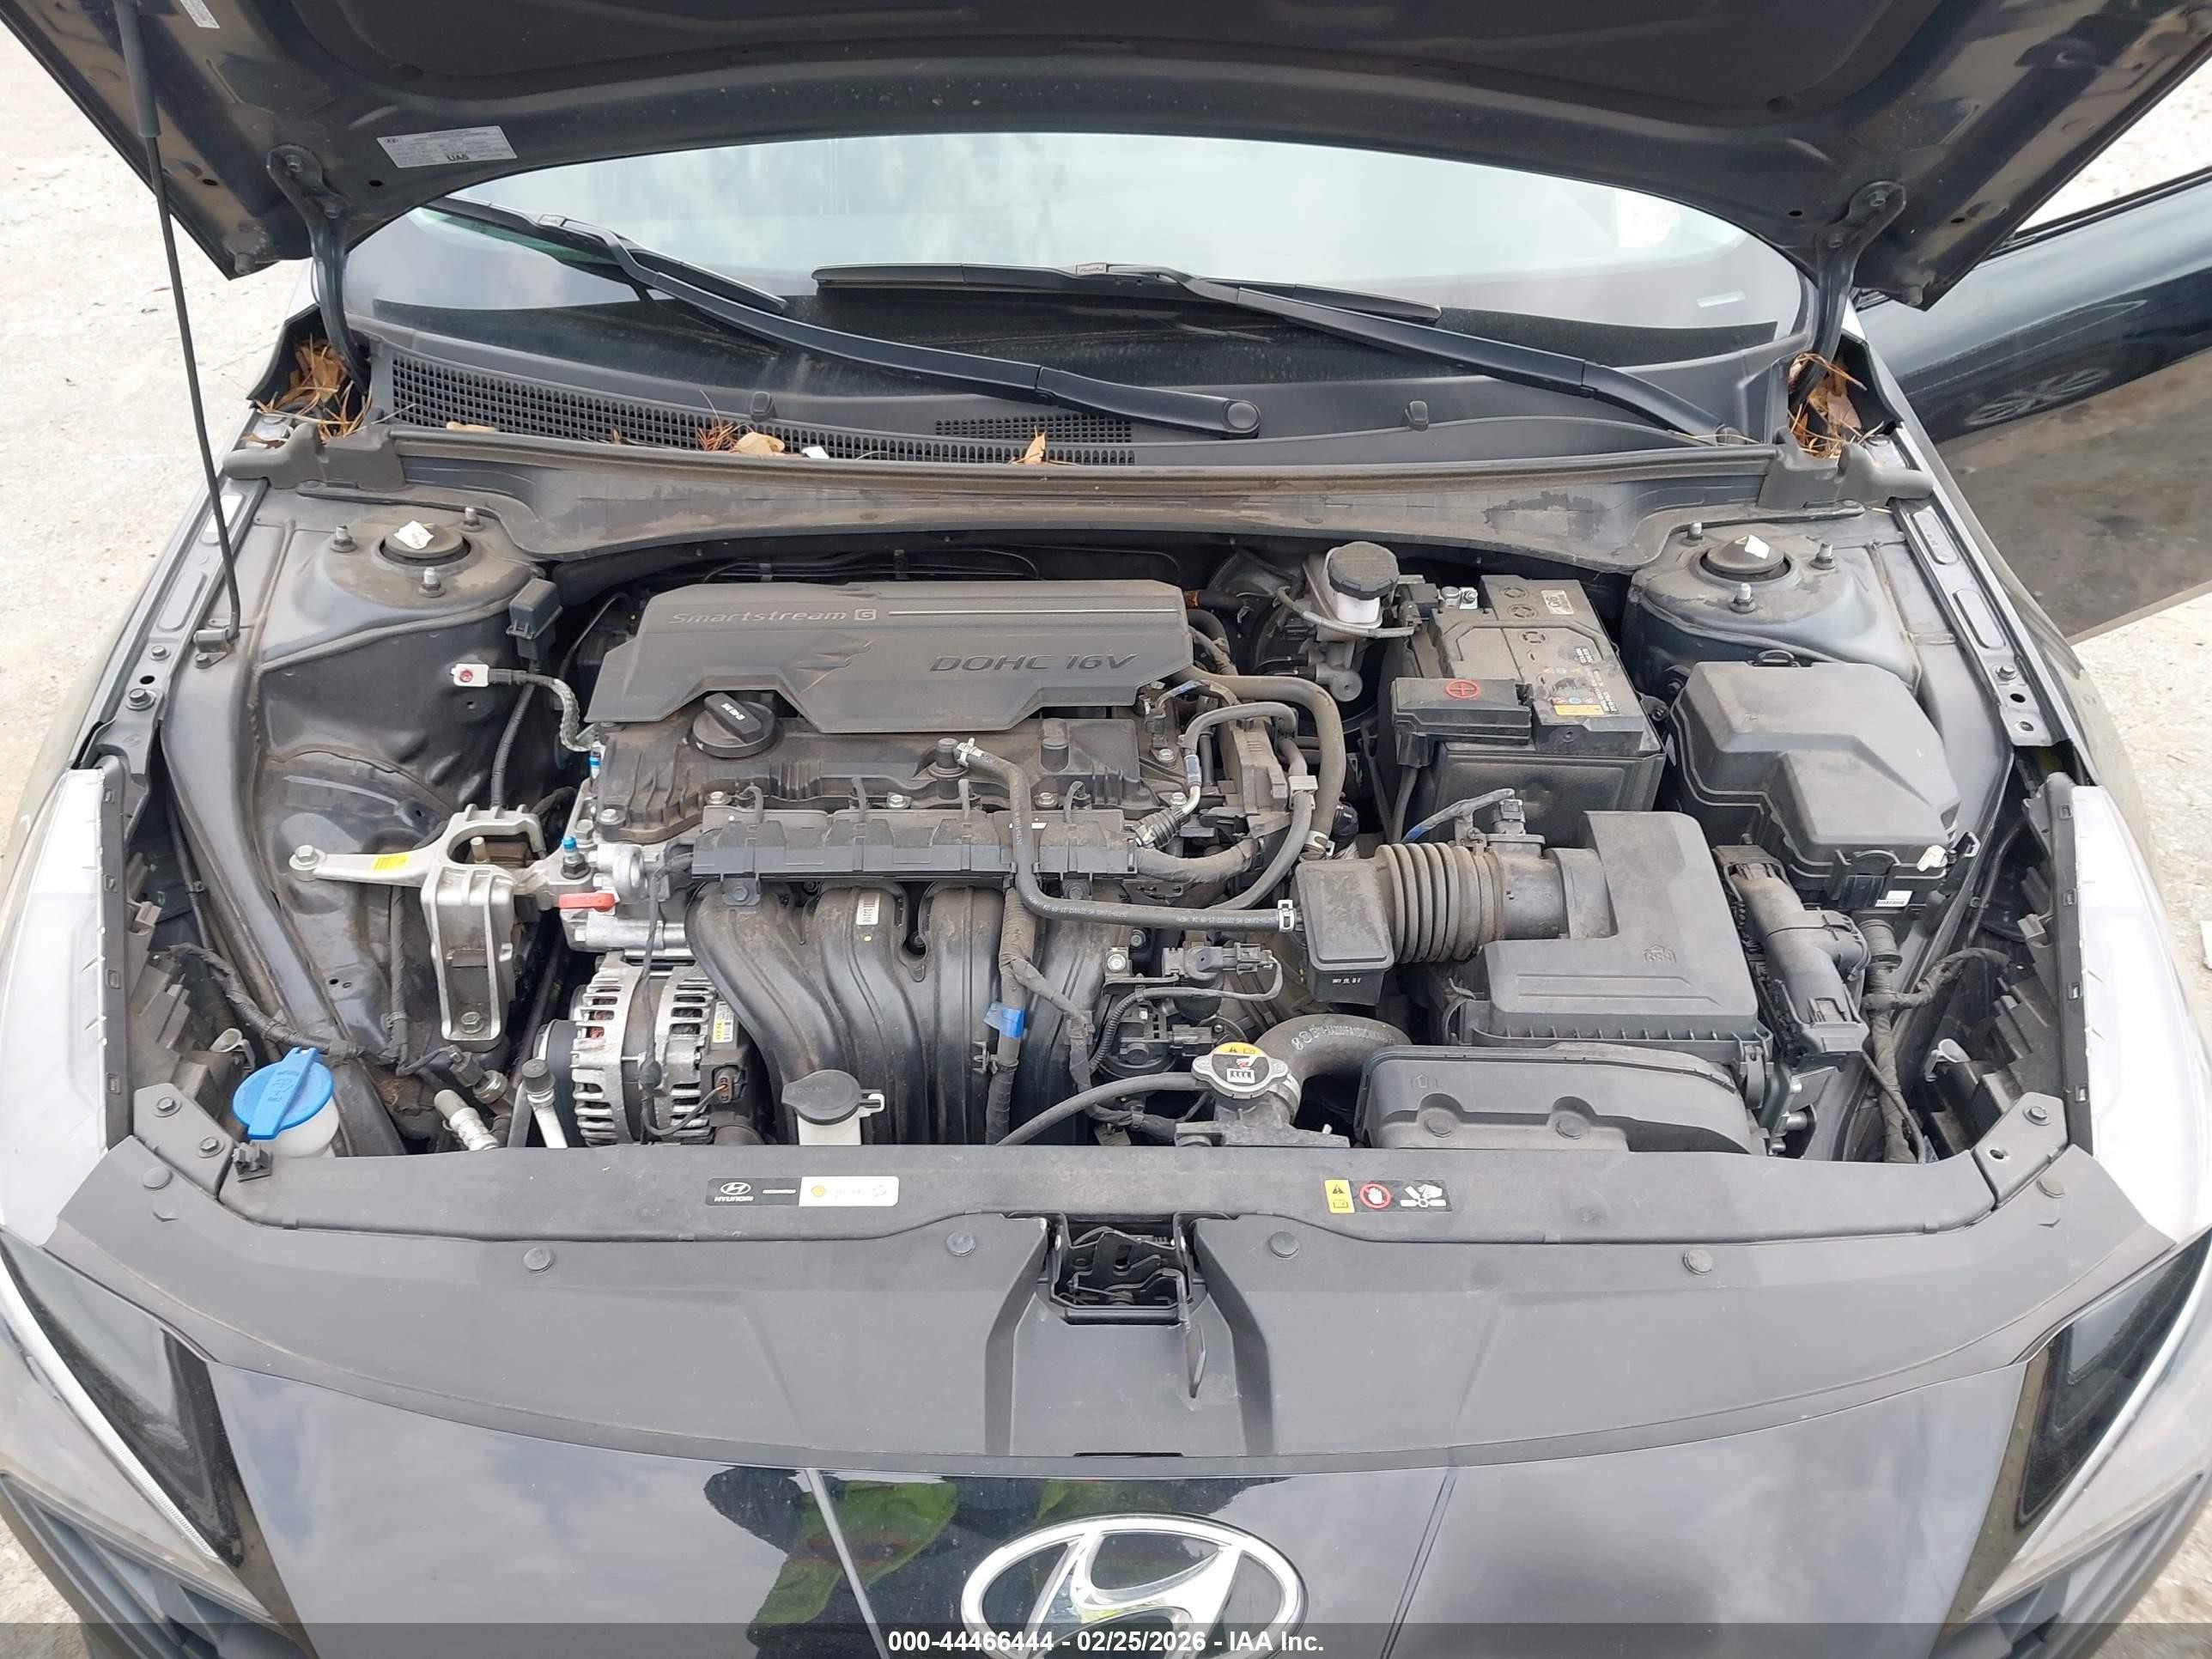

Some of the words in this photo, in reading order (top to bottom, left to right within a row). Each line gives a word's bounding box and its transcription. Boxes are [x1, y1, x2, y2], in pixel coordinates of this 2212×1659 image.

[668, 611, 847, 624] Smartstream
[930, 654, 1054, 672] DOHC
[1065, 653, 1139, 670] 16V
